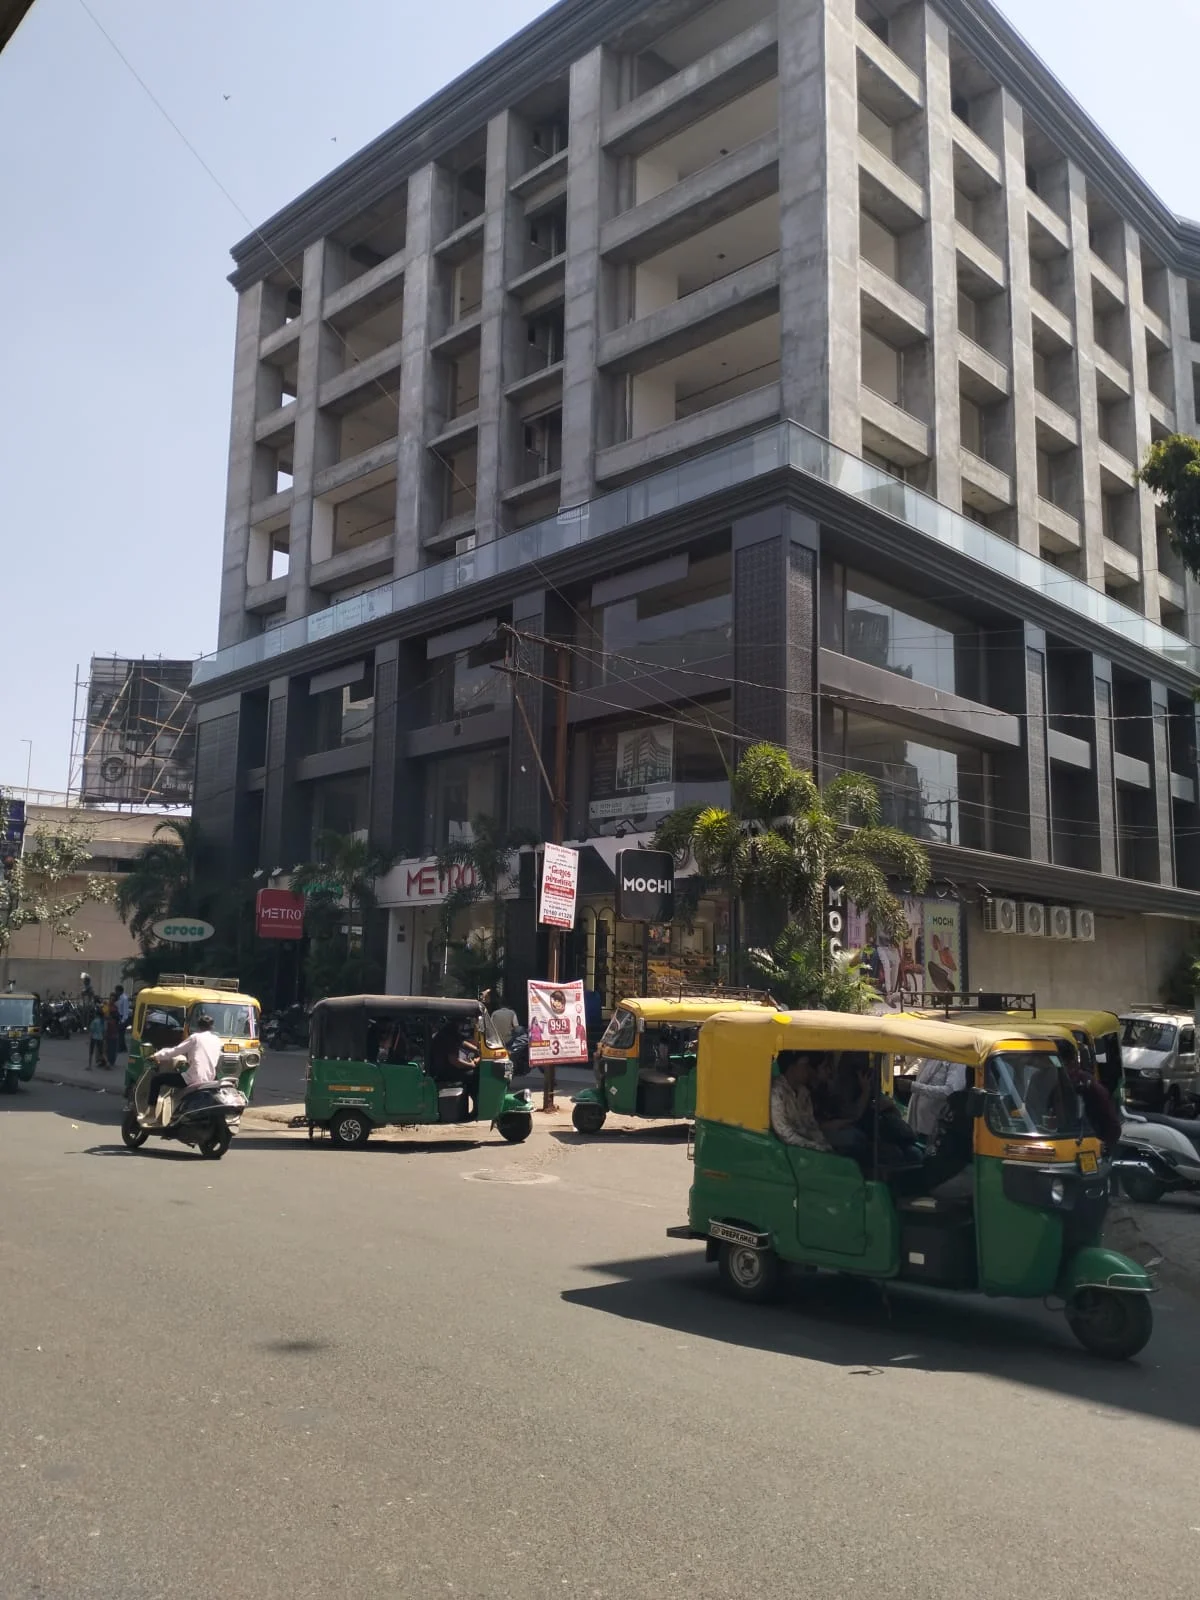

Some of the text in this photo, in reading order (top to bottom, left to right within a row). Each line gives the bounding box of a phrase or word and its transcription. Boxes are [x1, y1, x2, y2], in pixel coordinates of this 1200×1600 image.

[623, 877, 672, 894] MOCHI
[261, 907, 302, 921] METRO
[932, 915, 954, 927] MOCHI
[163, 924, 205, 936] crocs
[552, 1040, 560, 1055] 3
